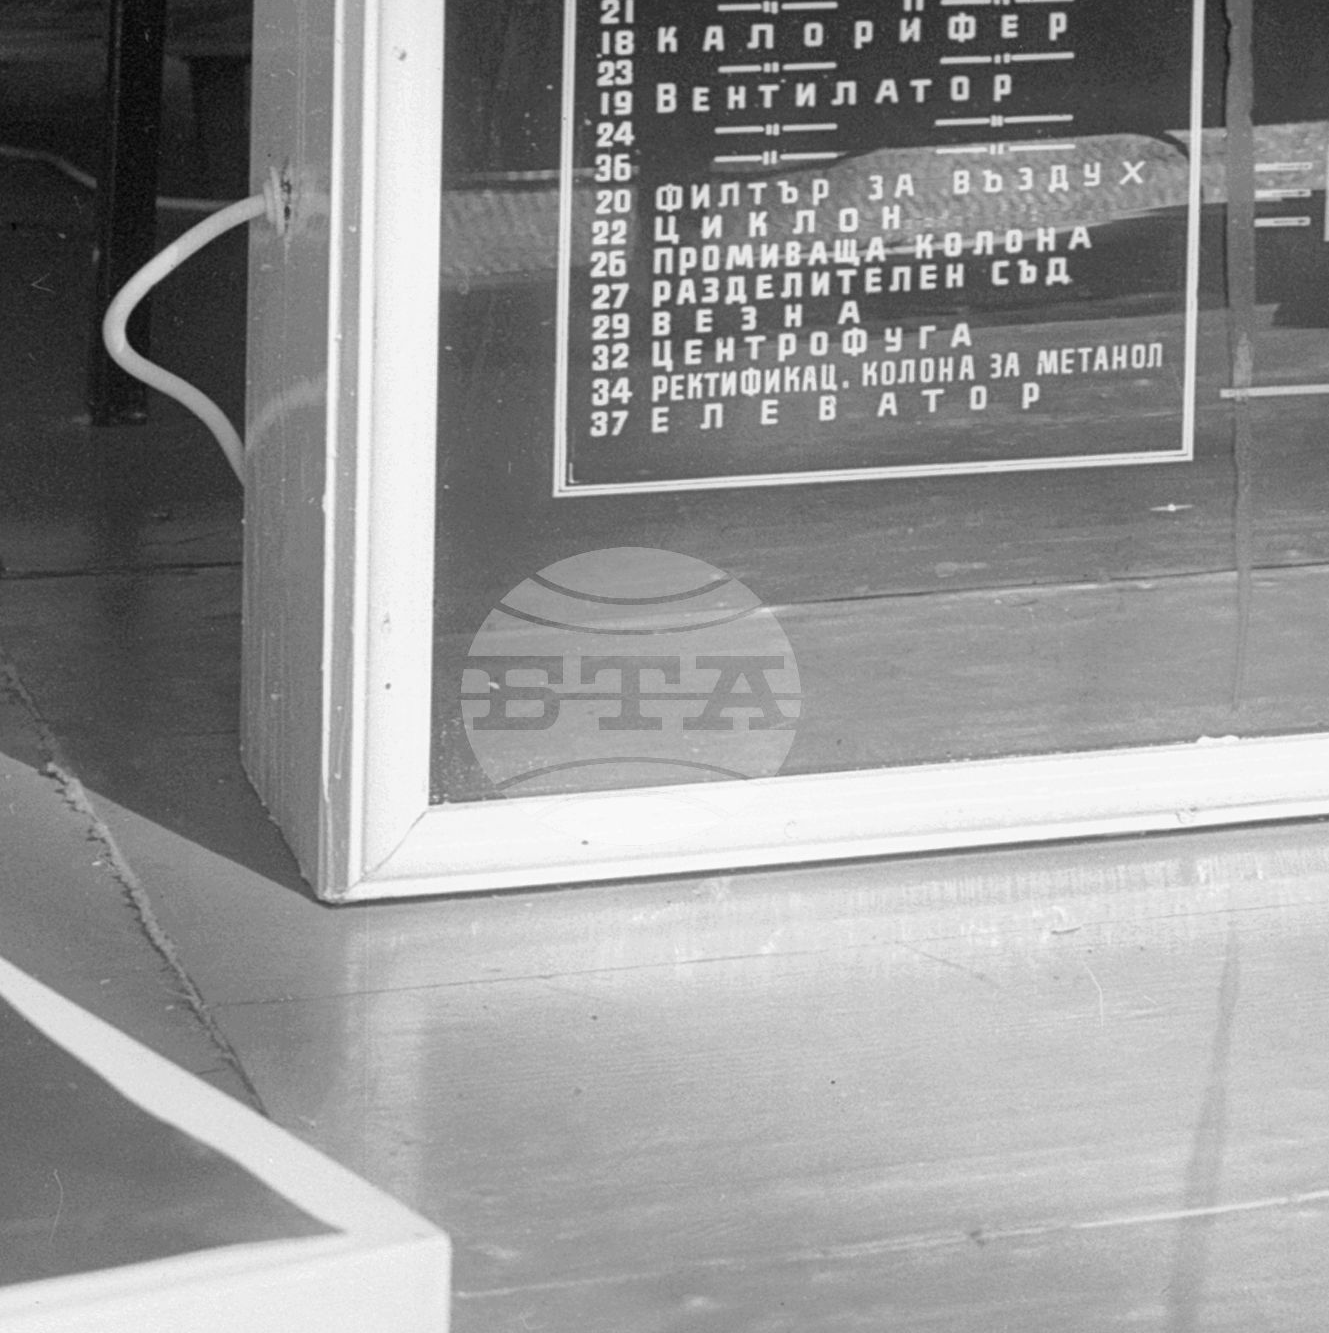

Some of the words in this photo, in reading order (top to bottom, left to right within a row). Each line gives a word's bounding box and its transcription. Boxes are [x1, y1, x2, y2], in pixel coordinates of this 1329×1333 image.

[601, 0, 633, 24] 21
[602, 31, 634, 55] 18
[658, 12, 1066, 52] КАЛОРИФЕР
[602, 91, 632, 115] 19
[657, 75, 1011, 113] ВЕНТИЛАТОР
[596, 190, 631, 214] 20
[656, 179, 828, 211] ФИЛТЪР
[869, 174, 914, 200] ЗА
[954, 161, 1144, 194] ВЪЗДУХ
[593, 220, 626, 245] 22
[655, 205, 899, 244] ЦИКЛОН
[591, 250, 626, 277] 26
[654, 237, 886, 275] ПРОМИВАЩА
[916, 226, 1091, 259] КОЛОНА
[592, 283, 629, 309] 27
[653, 264, 963, 308] РАЗДЕЛИТЕЛЕН
[992, 258, 1070, 285] СЪД
[592, 314, 629, 340] 29
[653, 301, 860, 335] ВЕЗНА
[592, 343, 628, 368] 32
[653, 323, 974, 370] ЦЕНТРОФУГА
[592, 378, 632, 406] 34
[652, 364, 848, 402] РЕКТИФИКАЦ.
[863, 358, 974, 386] КОЛОНА
[991, 352, 1019, 378] ЗА
[1037, 343, 1162, 375] МЕТАНОЛ
[591, 411, 628, 436] 37
[652, 382, 1039, 433] ЕЛЕВАТОР
